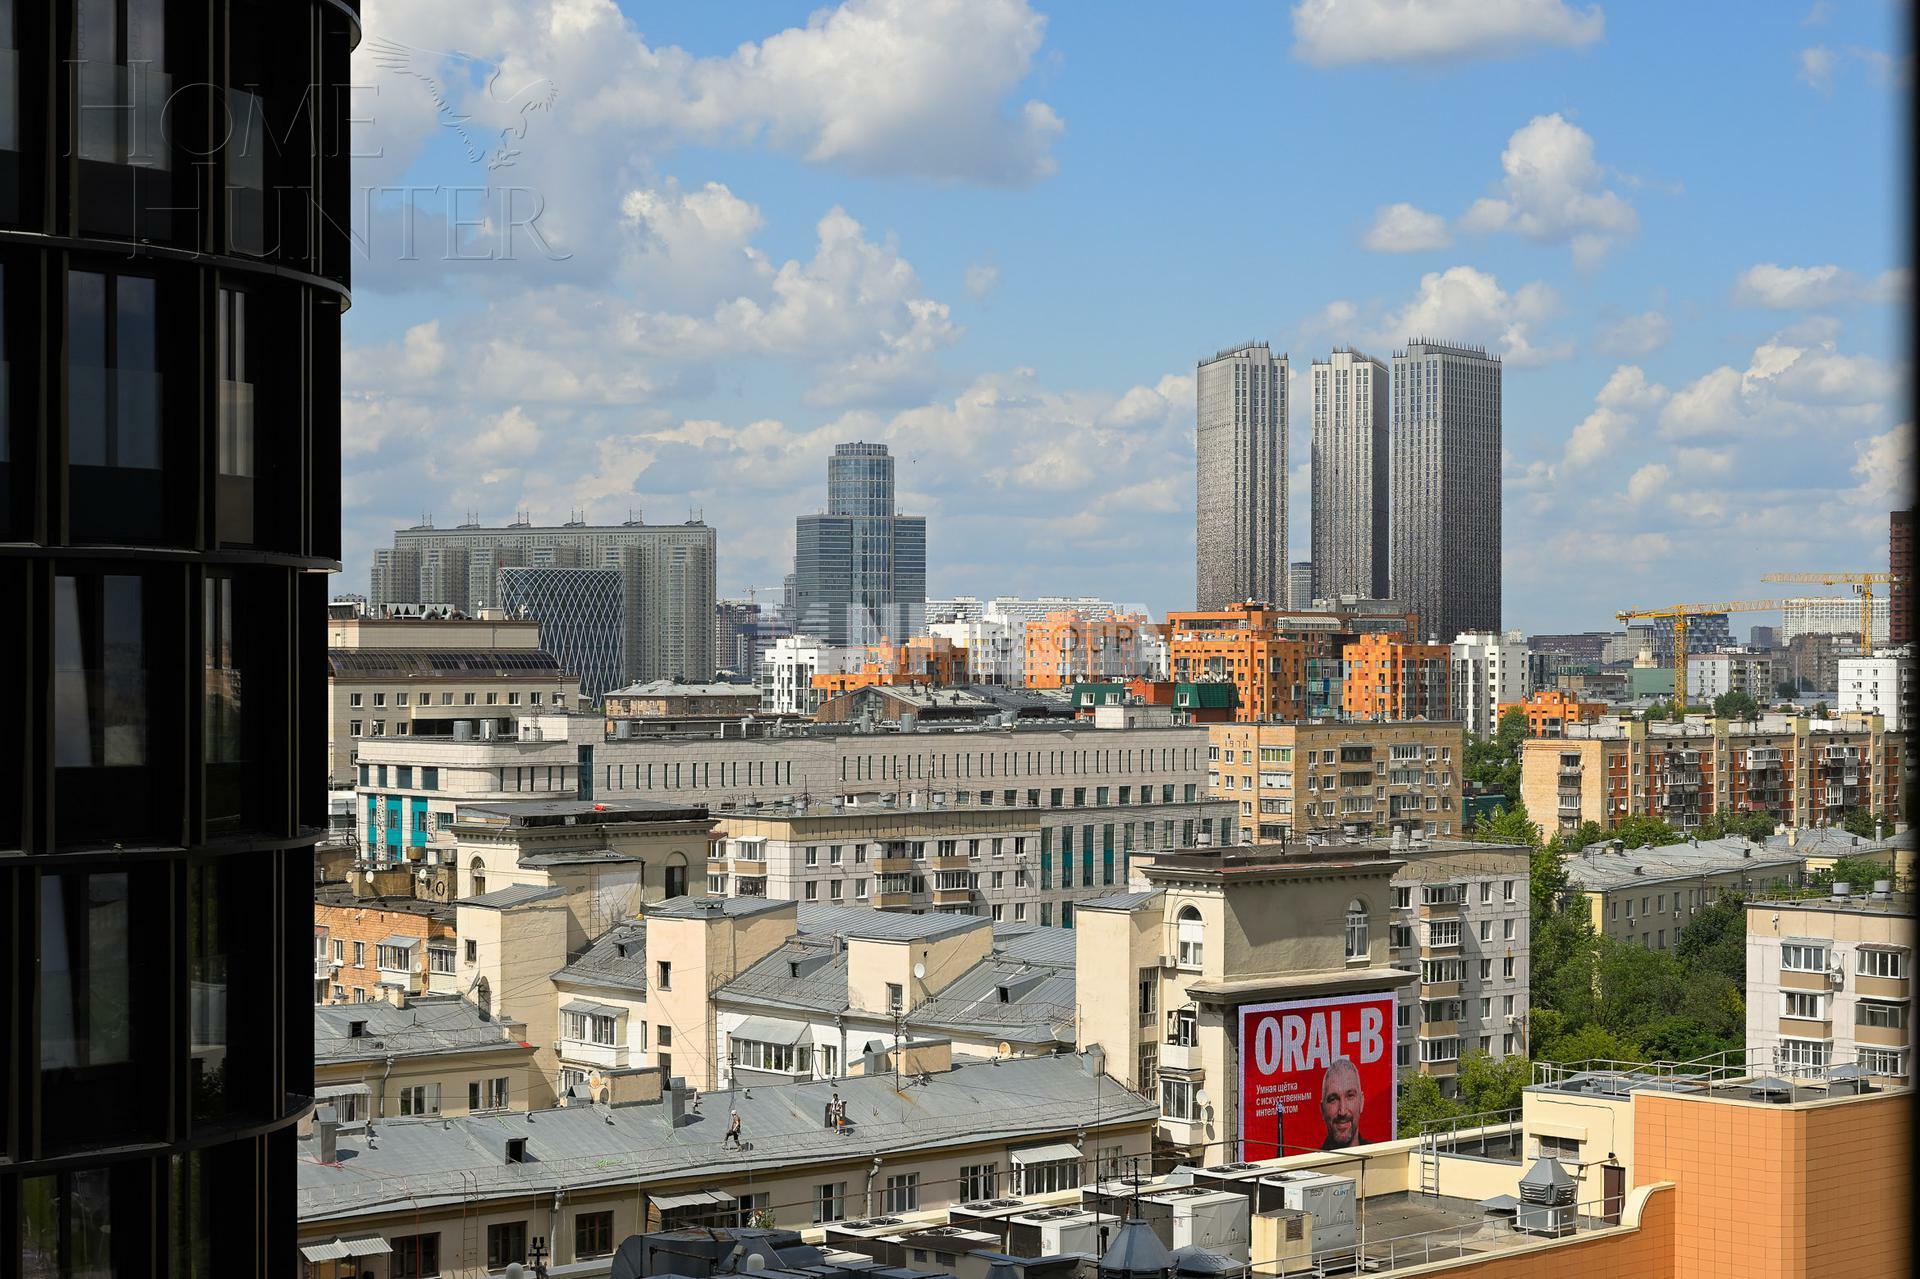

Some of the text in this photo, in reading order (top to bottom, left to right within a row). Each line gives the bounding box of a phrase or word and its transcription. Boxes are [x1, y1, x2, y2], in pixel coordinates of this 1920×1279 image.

[1255, 1007, 1384, 1075] ORAL-B
[1256, 1082, 1298, 1095] Умная щётка
[1256, 1092, 1312, 1106] с искусственным
